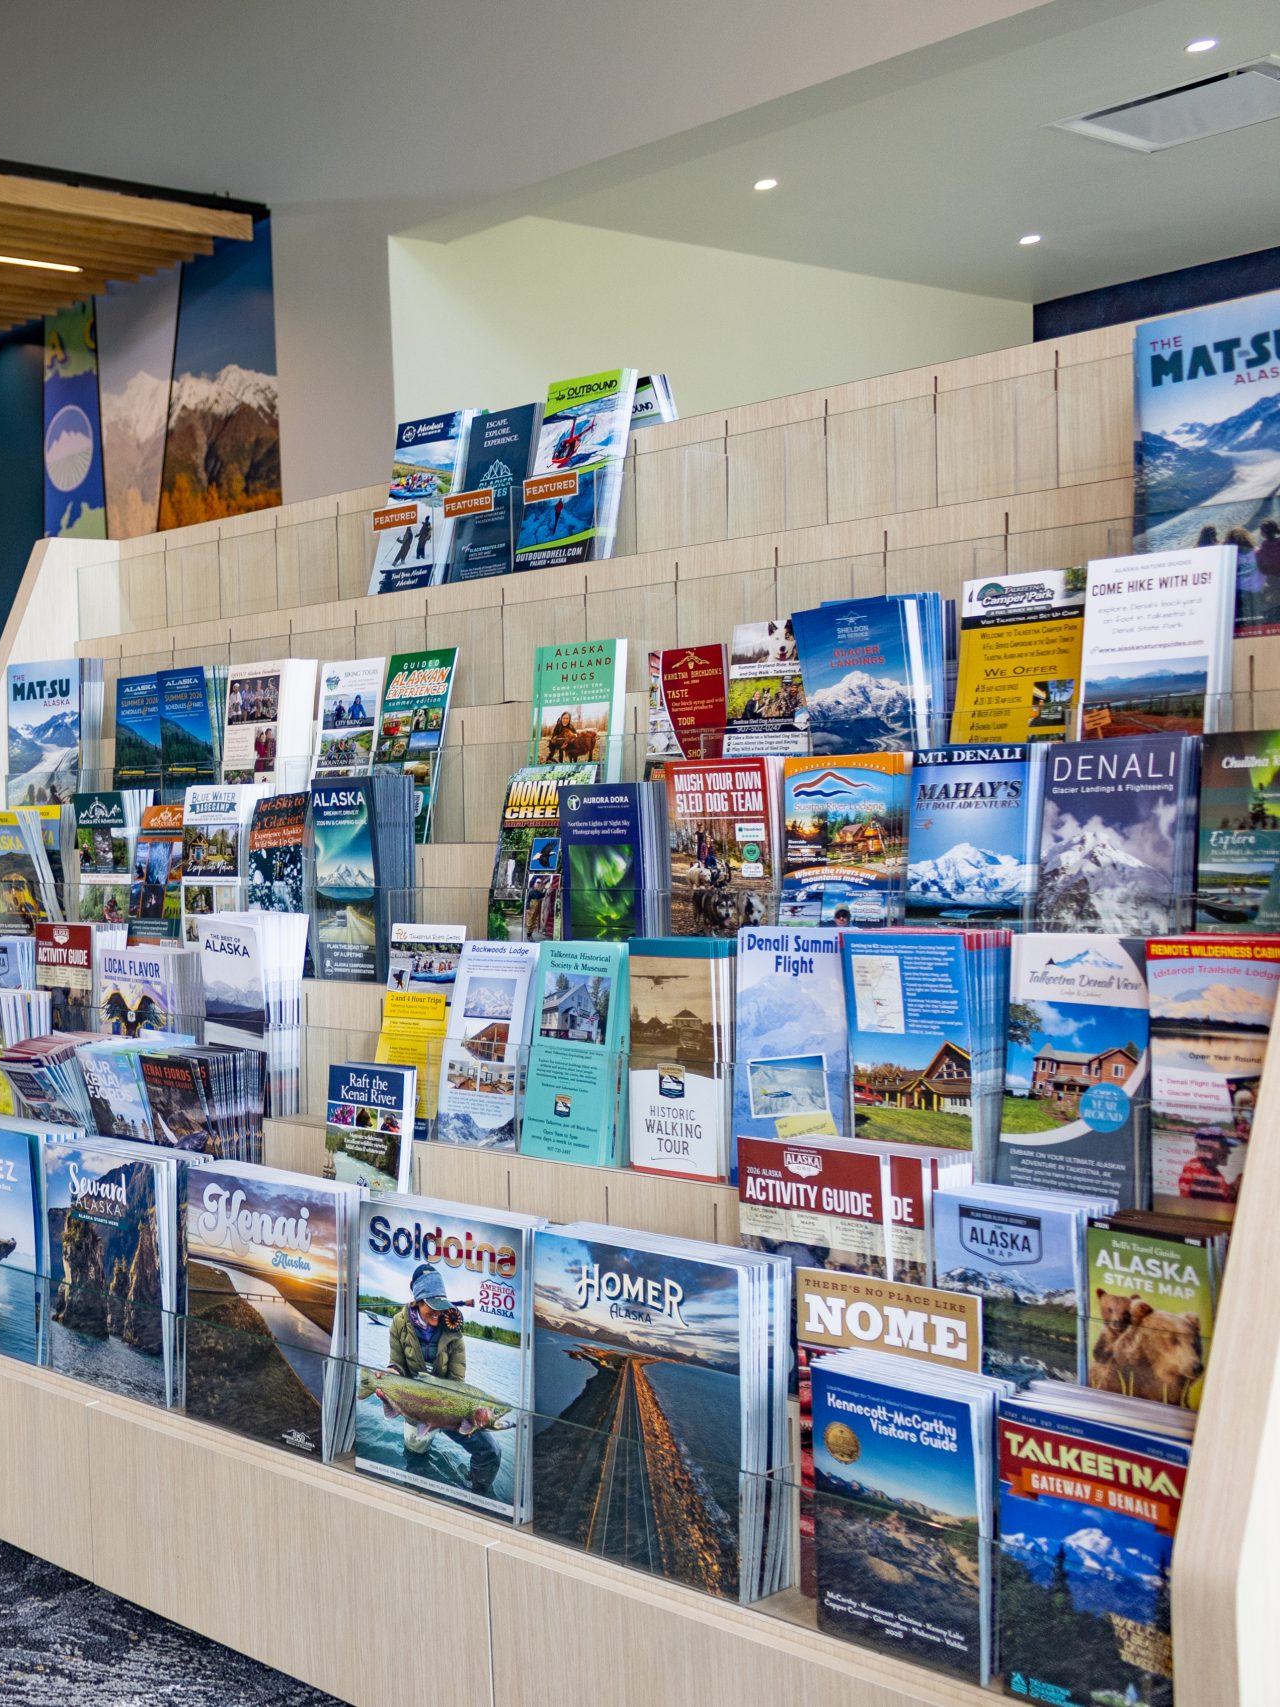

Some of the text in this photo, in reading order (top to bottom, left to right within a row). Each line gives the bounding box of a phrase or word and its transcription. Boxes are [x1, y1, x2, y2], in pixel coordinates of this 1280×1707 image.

[1150, 336, 1183, 351] THE
[567, 379, 618, 396] OUTBOUND
[526, 480, 576, 496] FEATURED
[445, 496, 491, 512] FEATURED
[374, 511, 417, 526] FEATURED
[515, 547, 583, 563] OUTBOUNDHELI.COM
[1092, 572, 1212, 597] COME HIKE WITH US!
[982, 588, 1055, 608] Camper Park
[836, 625, 869, 635] SHELDON
[555, 644, 604, 657] ALASKA
[833, 645, 880, 657] GLACIER
[403, 659, 440, 670] GUIDED
[546, 657, 612, 671] HIGHLAND
[830, 656, 885, 668] LANDINGS
[13, 674, 25, 682] THE
[392, 666, 451, 687] ALASKAN
[561, 672, 595, 682] HUGS
[984, 665, 1058, 677] WE OFFER
[13, 678, 70, 701] MAT-SU
[124, 684, 157, 693] ALASKA
[165, 678, 198, 687] ALASKA
[164, 693, 188, 702] SUMMER
[386, 682, 448, 700] EXPERIENCES
[667, 689, 689, 699] TASTE
[43, 699, 71, 707] ALASKA
[416, 697, 441, 705] edition
[347, 718, 363, 726] BIKING
[677, 717, 695, 726] TOUR
[918, 747, 1023, 765] MT. DENALI
[1053, 751, 1175, 782] DENALI
[673, 770, 762, 792] MUSH YOUR OWN
[1052, 782, 1174, 794] Glacier Landings & Flightseeing
[192, 790, 236, 803] BLUE WATER
[917, 780, 1024, 801] MAHAY'S
[313, 791, 366, 807] ALASKA
[583, 795, 629, 804] AURORA DORA
[676, 790, 764, 813] SLED DOG TEAM
[915, 799, 1021, 811] JET BOAT ADVENTURES
[195, 803, 230, 813] BASECAMP
[572, 828, 600, 836] Photography
[610, 828, 627, 836] Gallery
[794, 867, 877, 881] Where the rivers and
[801, 874, 843, 884] mountains
[205, 939, 251, 958] ALASKA
[472, 944, 530, 956] Backwoods Lodge
[747, 934, 790, 953] Denali
[793, 935, 839, 955] Summi
[38, 947, 89, 966] ACTIVITY GUIDE
[550, 950, 611, 963] Talkeetna Historical
[104, 957, 160, 979] LOCAL FLAVOR
[550, 960, 608, 973] Society & Museum
[775, 955, 814, 977] Flight
[1028, 971, 1143, 992] Talkeetna Denali View
[411, 995, 426, 1003] Hour
[427, 996, 442, 1004] Trips
[1188, 1052, 1210, 1061] Open
[83, 1072, 120, 1087] KENAI
[143, 1063, 191, 1082] KENAI FJORDS
[349, 1072, 388, 1091] Raft the
[87, 1085, 133, 1102] FJORDS
[341, 1085, 397, 1106] Kenai River
[649, 1105, 696, 1121] HISTORIC
[1091, 1100, 1118, 1111] YEAR
[1083, 1108, 1123, 1122] ROUND
[644, 1119, 702, 1140] WALKING
[656, 1137, 690, 1156] TOUR
[786, 1154, 821, 1169] ALASKA
[1009, 1148, 1127, 1171] EMBARK ON YOUR ULTIMATE ALASKAN
[746, 1166, 783, 1179] 2026 ALASKA
[69, 1162, 127, 1206] Seward
[746, 1176, 874, 1217] ACTIVITY GUIDE
[75, 1197, 122, 1217] ALASKA
[78, 1213, 93, 1221] ALASKA
[93, 1216, 108, 1225] STARTS
[197, 1182, 313, 1257] Kenai
[800, 1219, 816, 1227] MAPS
[368, 1215, 517, 1279] Soldotna
[970, 1226, 1032, 1253] ALASKA
[271, 1250, 312, 1271] Alaska
[986, 1248, 1013, 1259] MAP
[1096, 1249, 1201, 1286] ALASKA
[480, 1281, 516, 1297] AMERICA
[1103, 1272, 1195, 1300] STATE MAP
[479, 1289, 516, 1312] 250
[577, 1263, 689, 1327] HOMER
[804, 1278, 967, 1314] THERE'S NO PLACE LIKE
[479, 1304, 516, 1320] ALASKA
[610, 1303, 652, 1324] ALASKA
[803, 1293, 968, 1361] NOME
[826, 1392, 957, 1441] Kennecott-McCarthy
[870, 1418, 958, 1453] Visitors Guide
[1004, 1431, 1181, 1499] TALKEETNA
